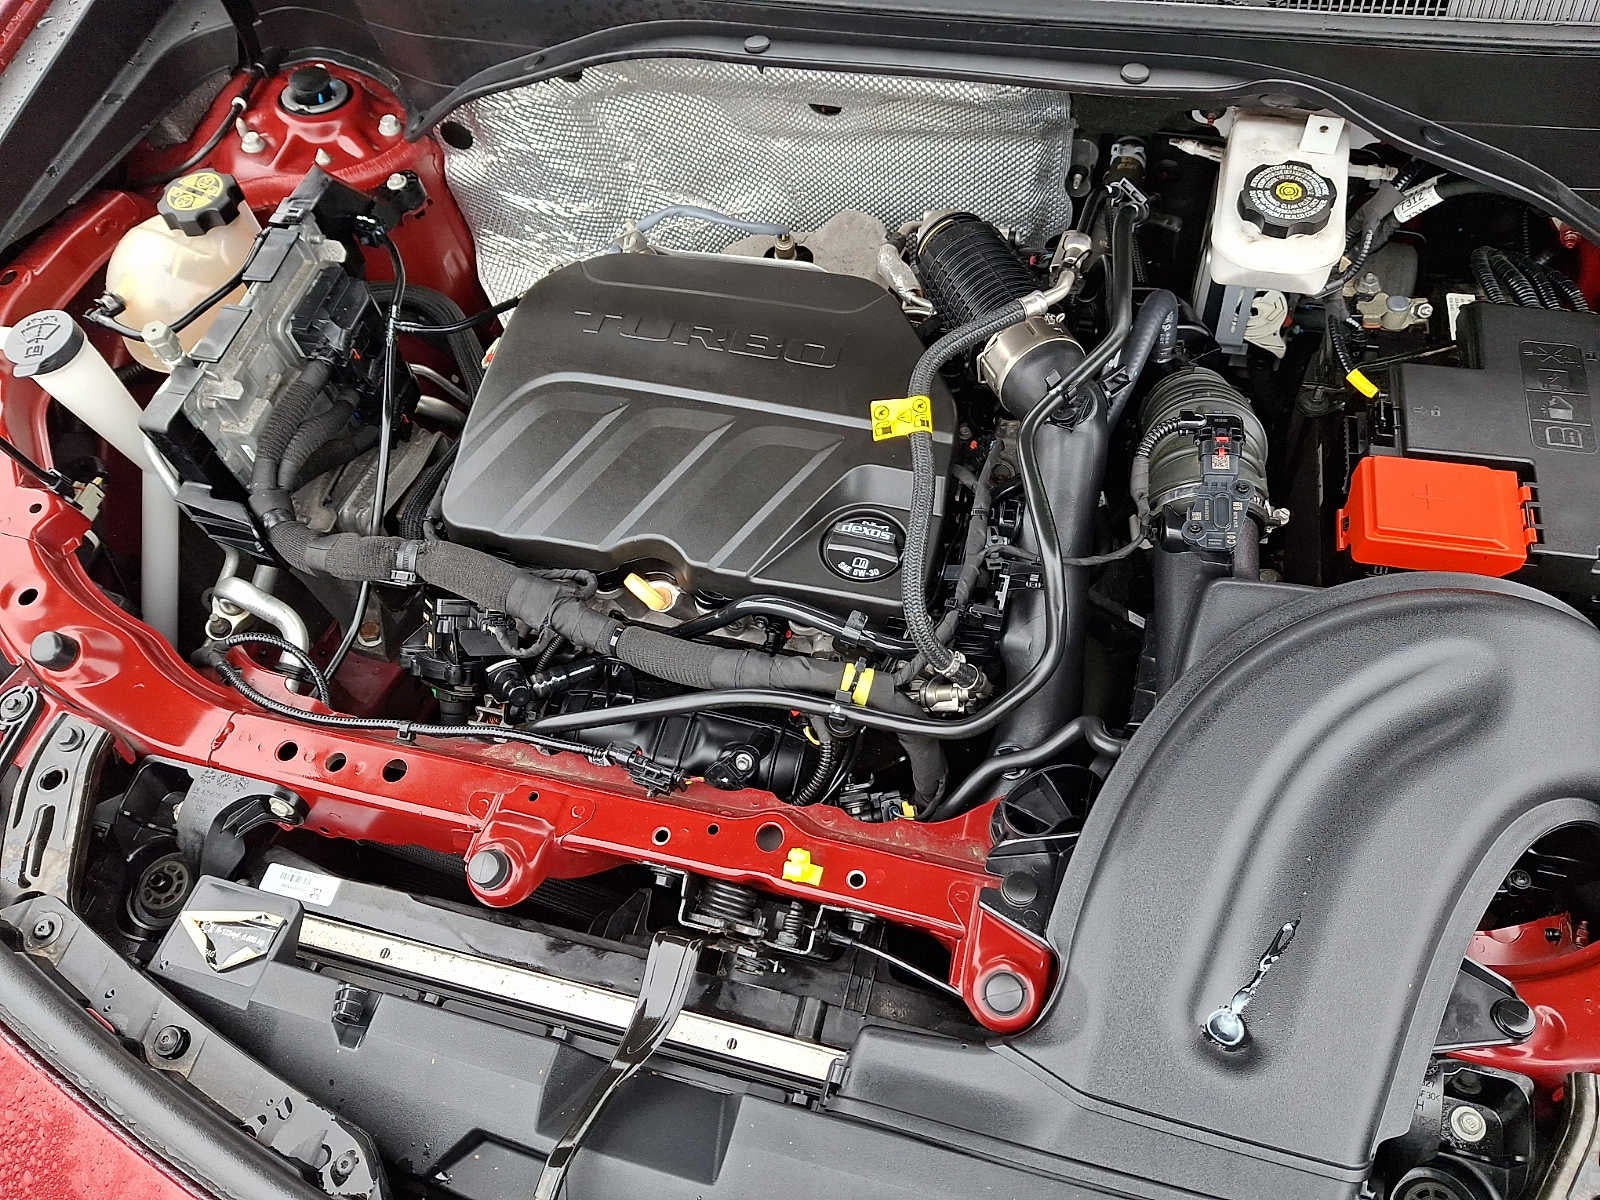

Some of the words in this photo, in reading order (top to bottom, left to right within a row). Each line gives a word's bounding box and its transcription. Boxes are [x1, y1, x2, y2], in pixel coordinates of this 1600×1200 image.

[573, 311, 841, 369] TURBO
[841, 522, 892, 541] dexos
[838, 561, 853, 574] SAE
[852, 567, 880, 578] 5W-30
